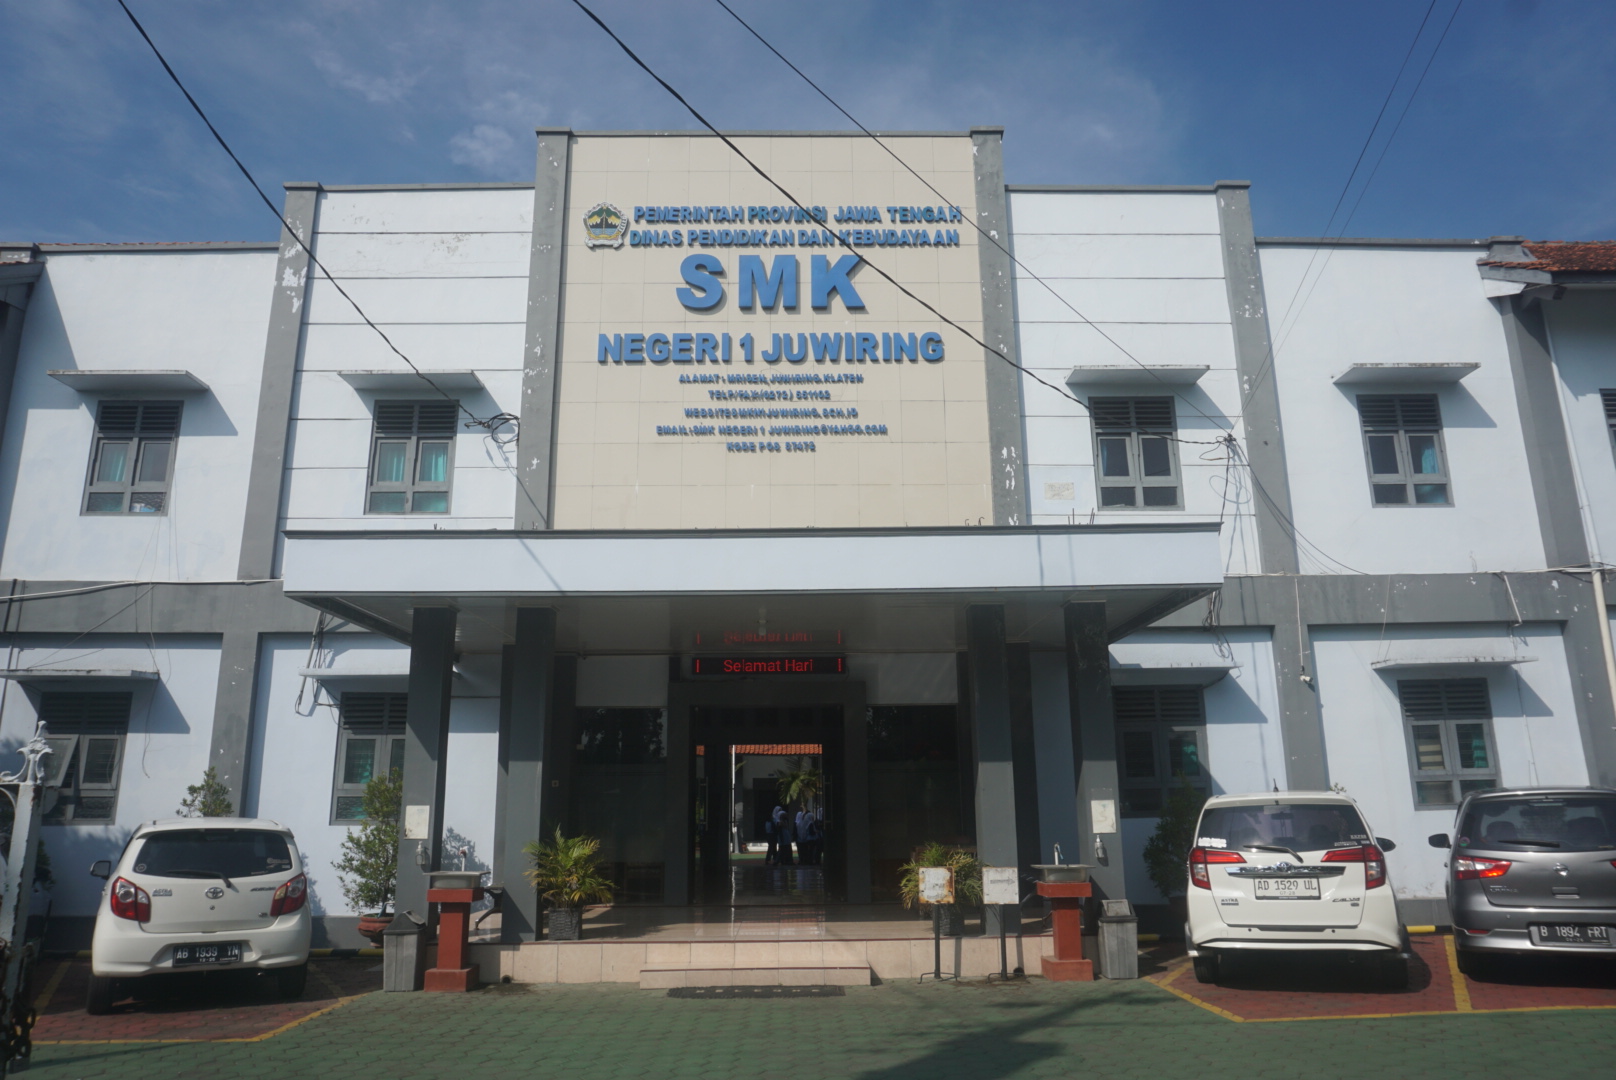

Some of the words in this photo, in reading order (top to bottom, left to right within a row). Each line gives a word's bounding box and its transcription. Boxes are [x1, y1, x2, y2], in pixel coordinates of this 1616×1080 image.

[633, 206, 744, 222] PEMERINTAH
[748, 206, 827, 222] PROVINSI
[834, 206, 882, 222] JAWA
[887, 206, 963, 222] TENGAH
[629, 229, 684, 245] DINAS
[687, 229, 794, 245] PENDIDIKAN
[797, 229, 835, 245] DAN
[838, 229, 960, 245] KEBUDAYAAN
[676, 253, 866, 310] SMK
[598, 332, 730, 362] NEGERI
[739, 332, 753, 362] 1
[761, 331, 945, 362] JUWIRING
[726, 441, 756, 452] KODE
[758, 441, 780, 452] POS
[723, 659, 781, 672] Selamat
[785, 658, 813, 672] Hari
[1257, 880, 1270, 891] AD
[1274, 880, 1299, 891] 1529
[1303, 880, 1317, 891] UL
[1540, 926, 1548, 937] B
[1555, 926, 1580, 938] 1894
[196, 946, 218, 958] 1939
